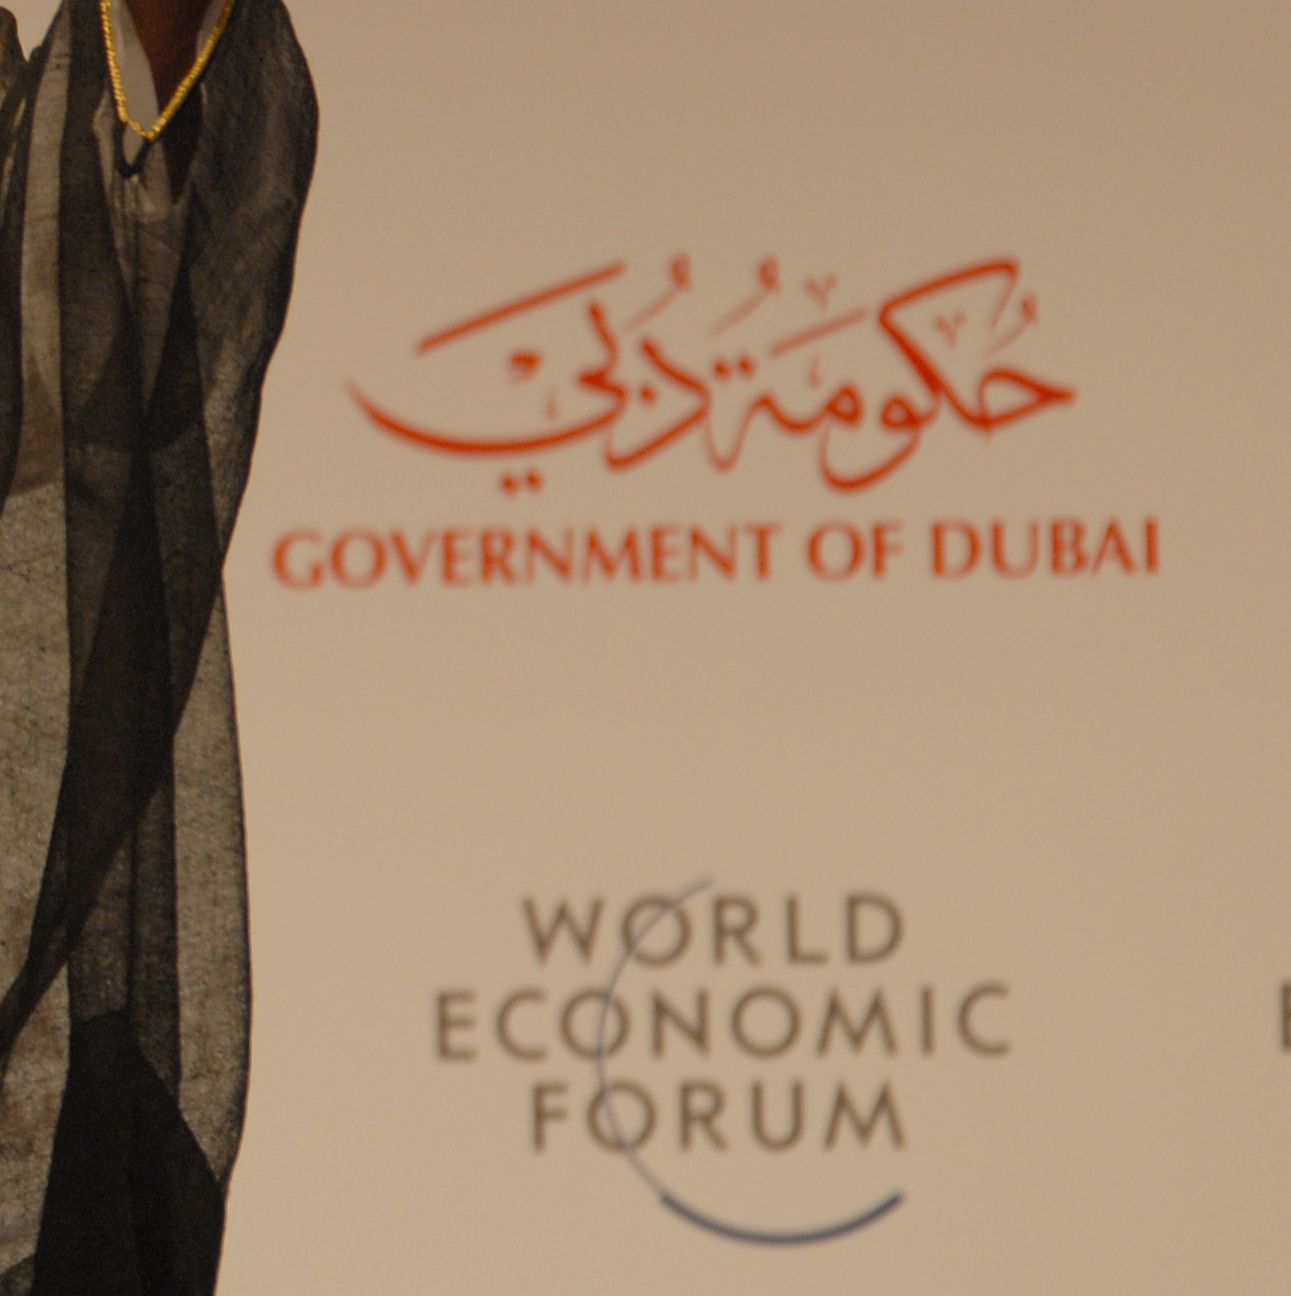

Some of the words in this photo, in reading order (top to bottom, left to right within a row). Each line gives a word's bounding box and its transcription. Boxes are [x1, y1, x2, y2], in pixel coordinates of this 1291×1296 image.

[270, 523, 781, 590] GOVERNMENT
[806, 519, 903, 581] OF
[930, 516, 1160, 580] DUBAI
[522, 892, 905, 969] WORLD
[435, 983, 1013, 1062] ECONOMIC
[531, 1080, 908, 1155] FORUM
